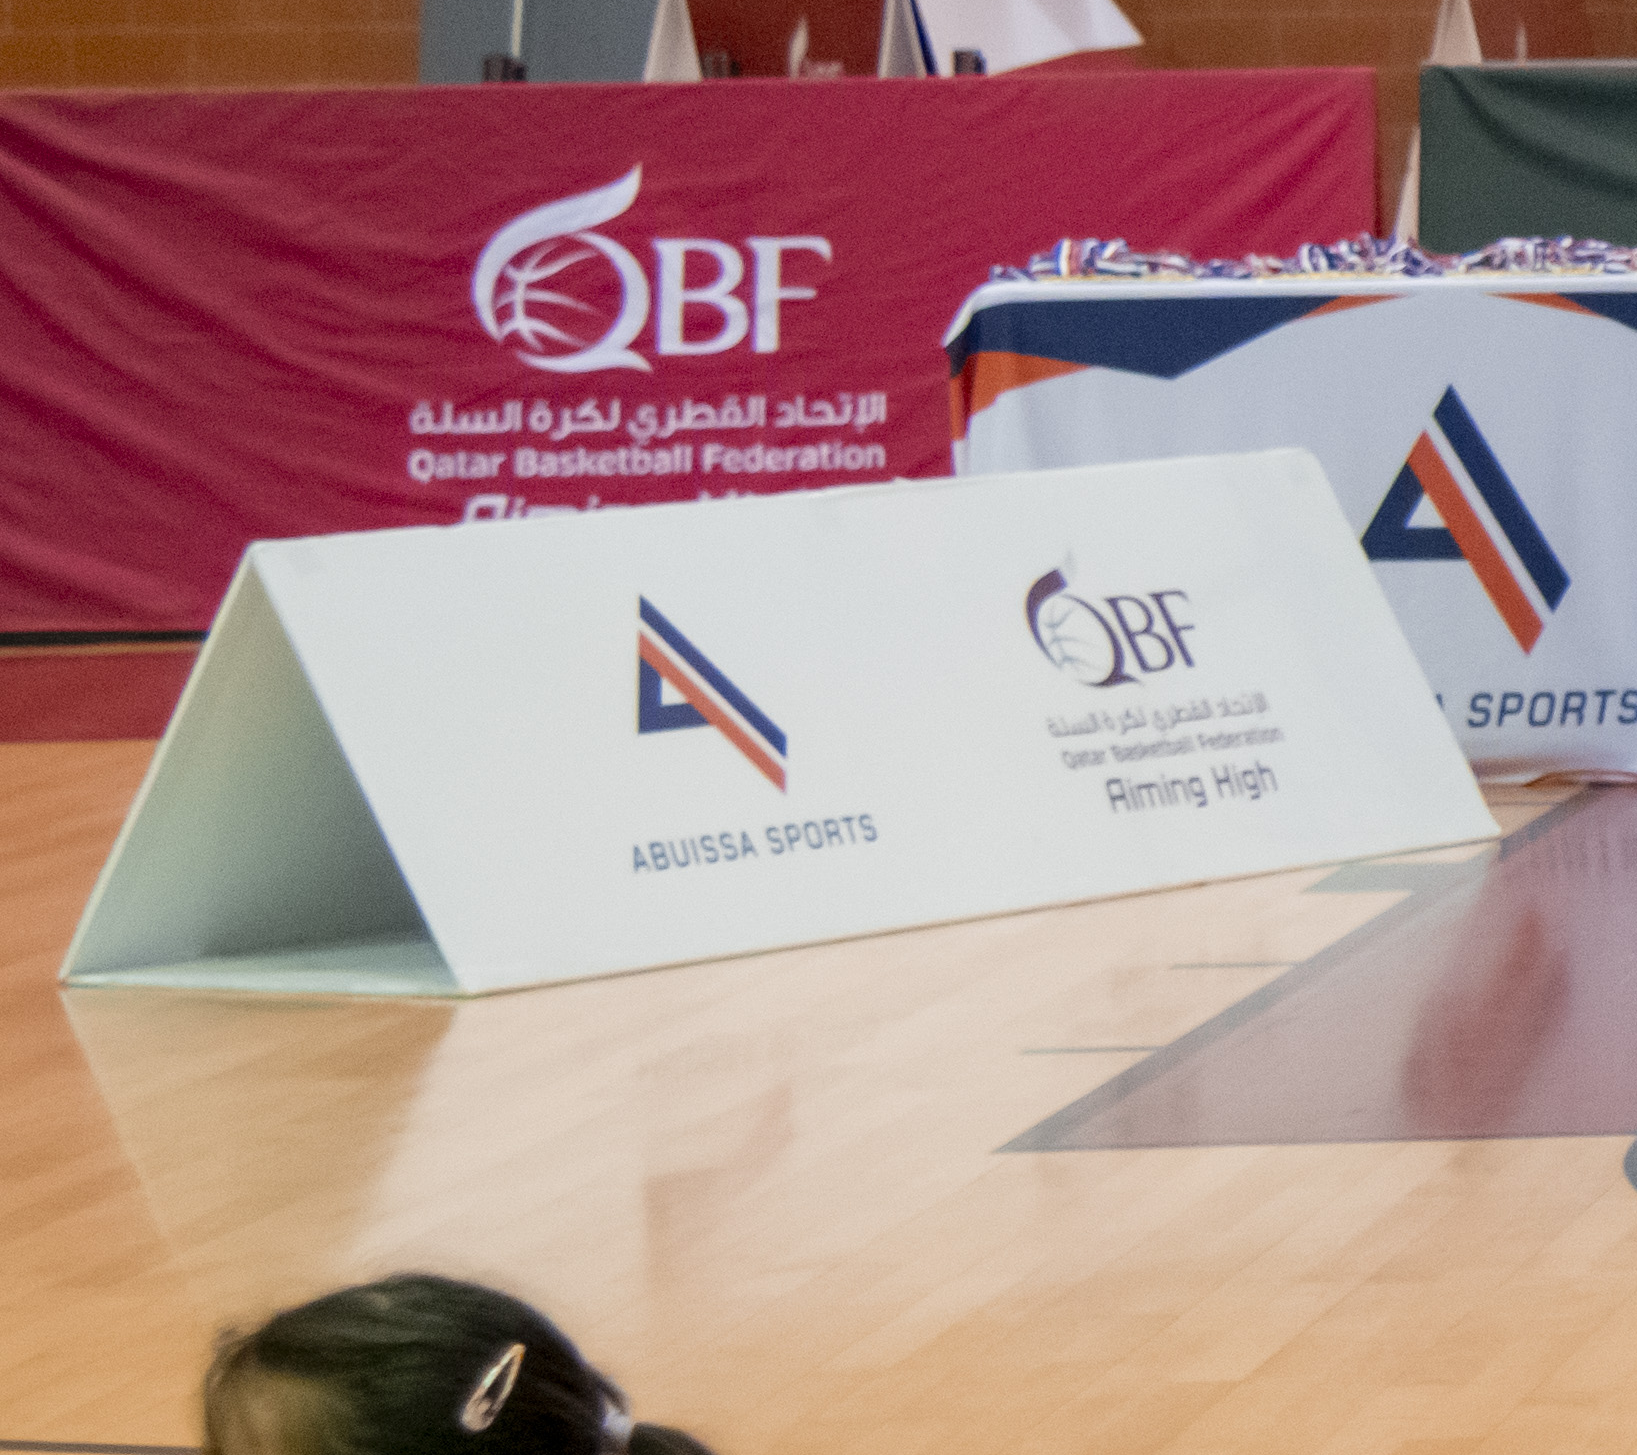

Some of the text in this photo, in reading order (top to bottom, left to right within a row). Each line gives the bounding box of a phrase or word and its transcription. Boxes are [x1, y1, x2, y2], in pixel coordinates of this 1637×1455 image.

[471, 161, 832, 374] QBF
[408, 442, 886, 483] Qatar Basketball Federation
[1024, 567, 1196, 688] QBF
[1105, 760, 1278, 813] Aiming High
[632, 814, 878, 873] ABUISSA SPORTS
